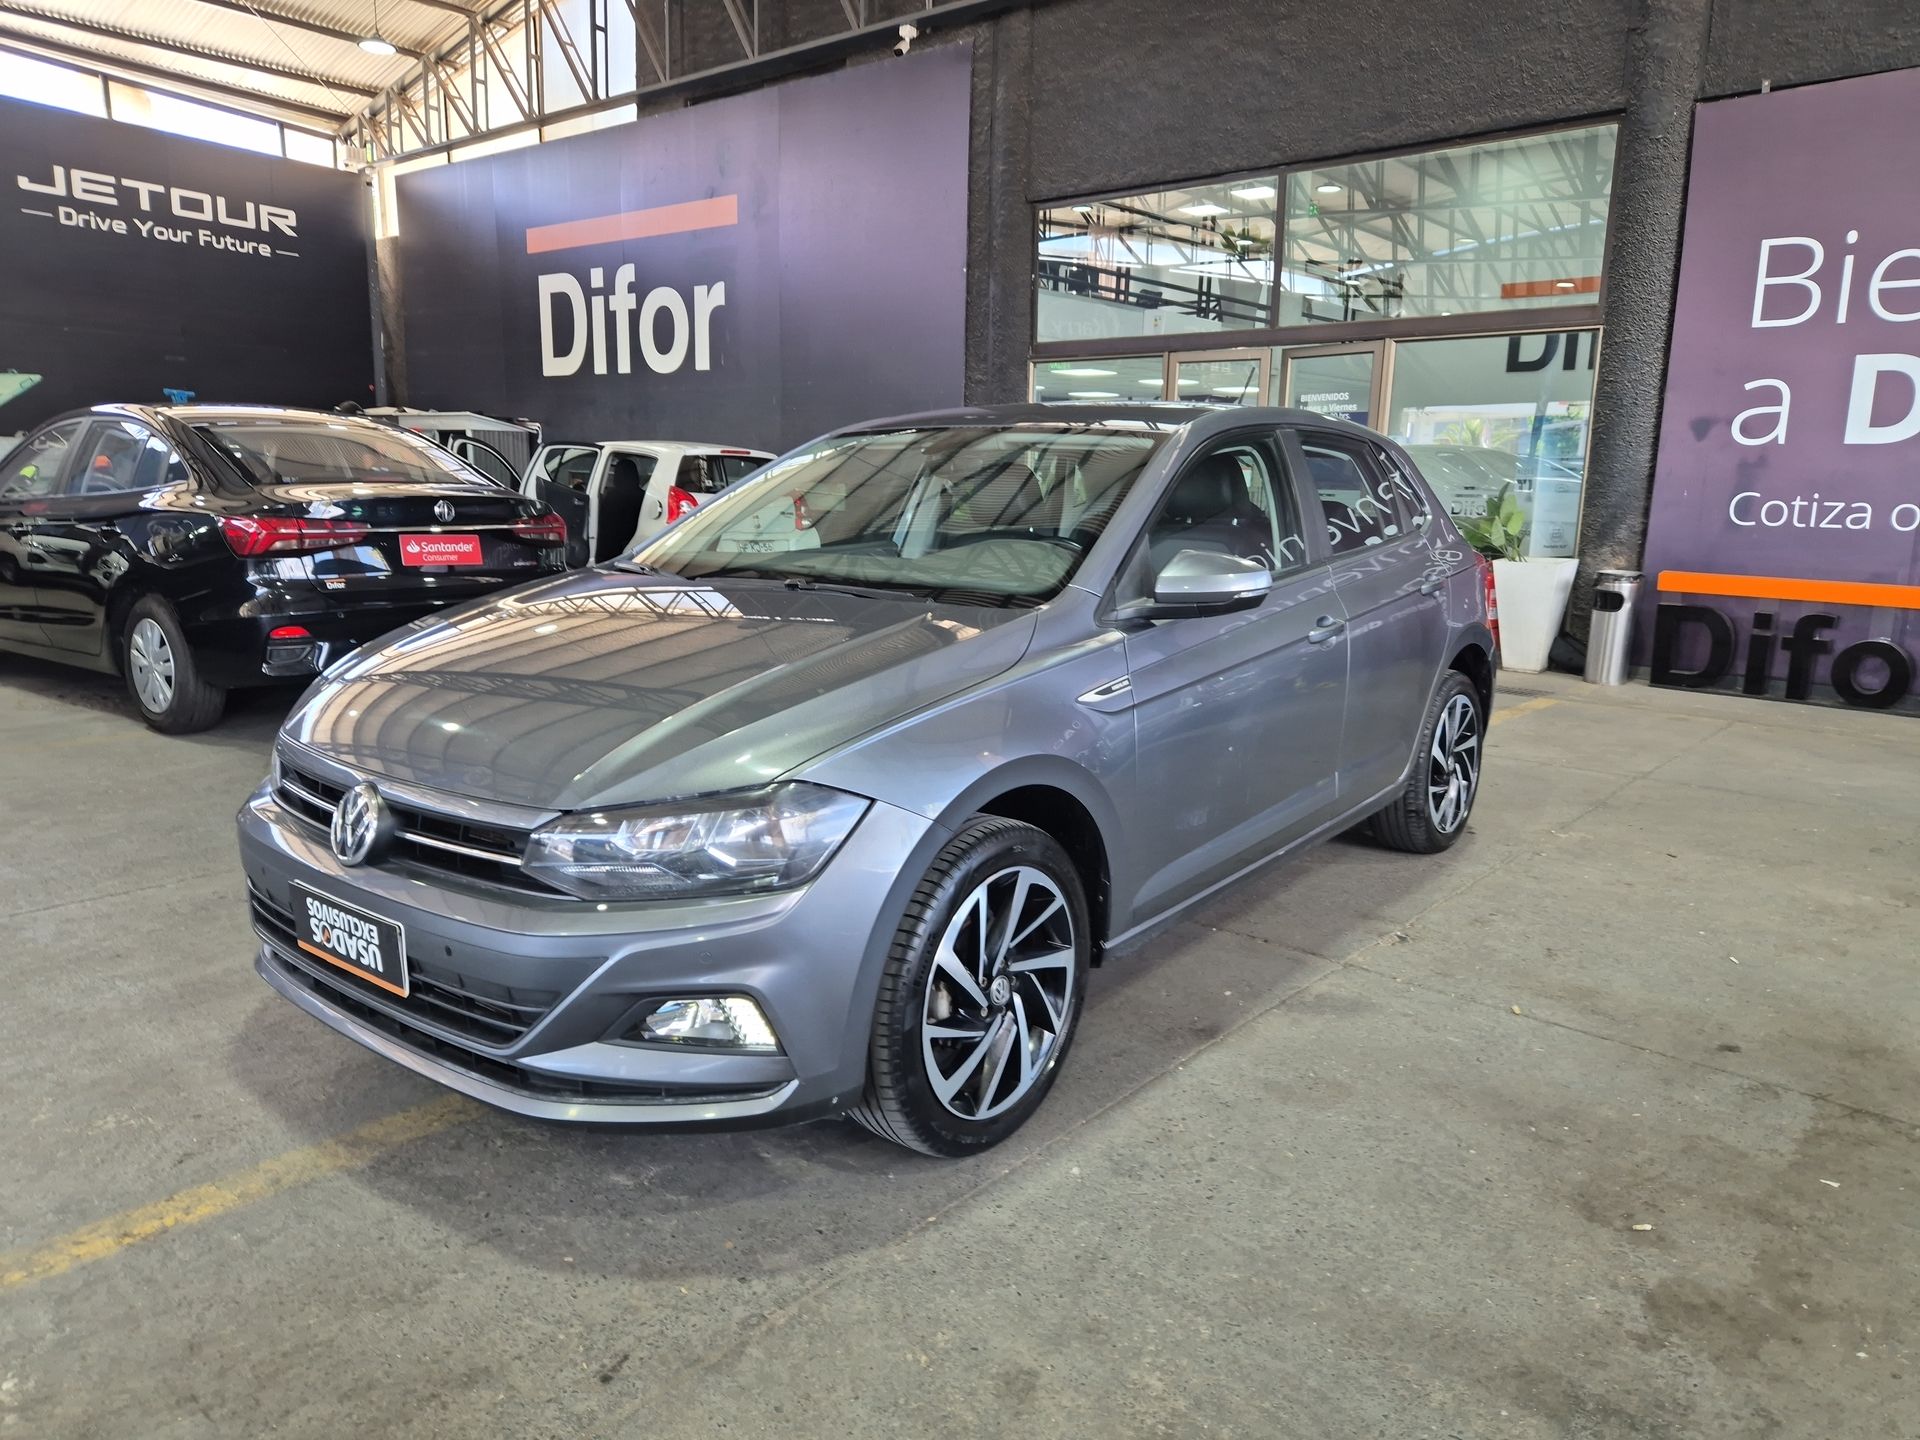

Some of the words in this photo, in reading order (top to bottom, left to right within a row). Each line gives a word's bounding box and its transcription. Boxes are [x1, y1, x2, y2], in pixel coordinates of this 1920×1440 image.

[17, 164, 299, 238] JETOUR
[58, 206, 128, 234] Drive
[133, 217, 192, 244] Your
[198, 228, 272, 258] Future
[1751, 229, 1920, 329] Bie
[538, 263, 726, 377] Difor
[1300, 392, 1349, 402] BIENVENIDOS
[1730, 377, 1792, 446] a
[1728, 490, 1872, 531] Cotiza
[421, 541, 474, 552] Santander
[422, 553, 459, 562] Consumer
[1649, 603, 1915, 708] Difo
[305, 896, 380, 946] EXCLUSIVOS
[309, 917, 384, 973] USADOS
